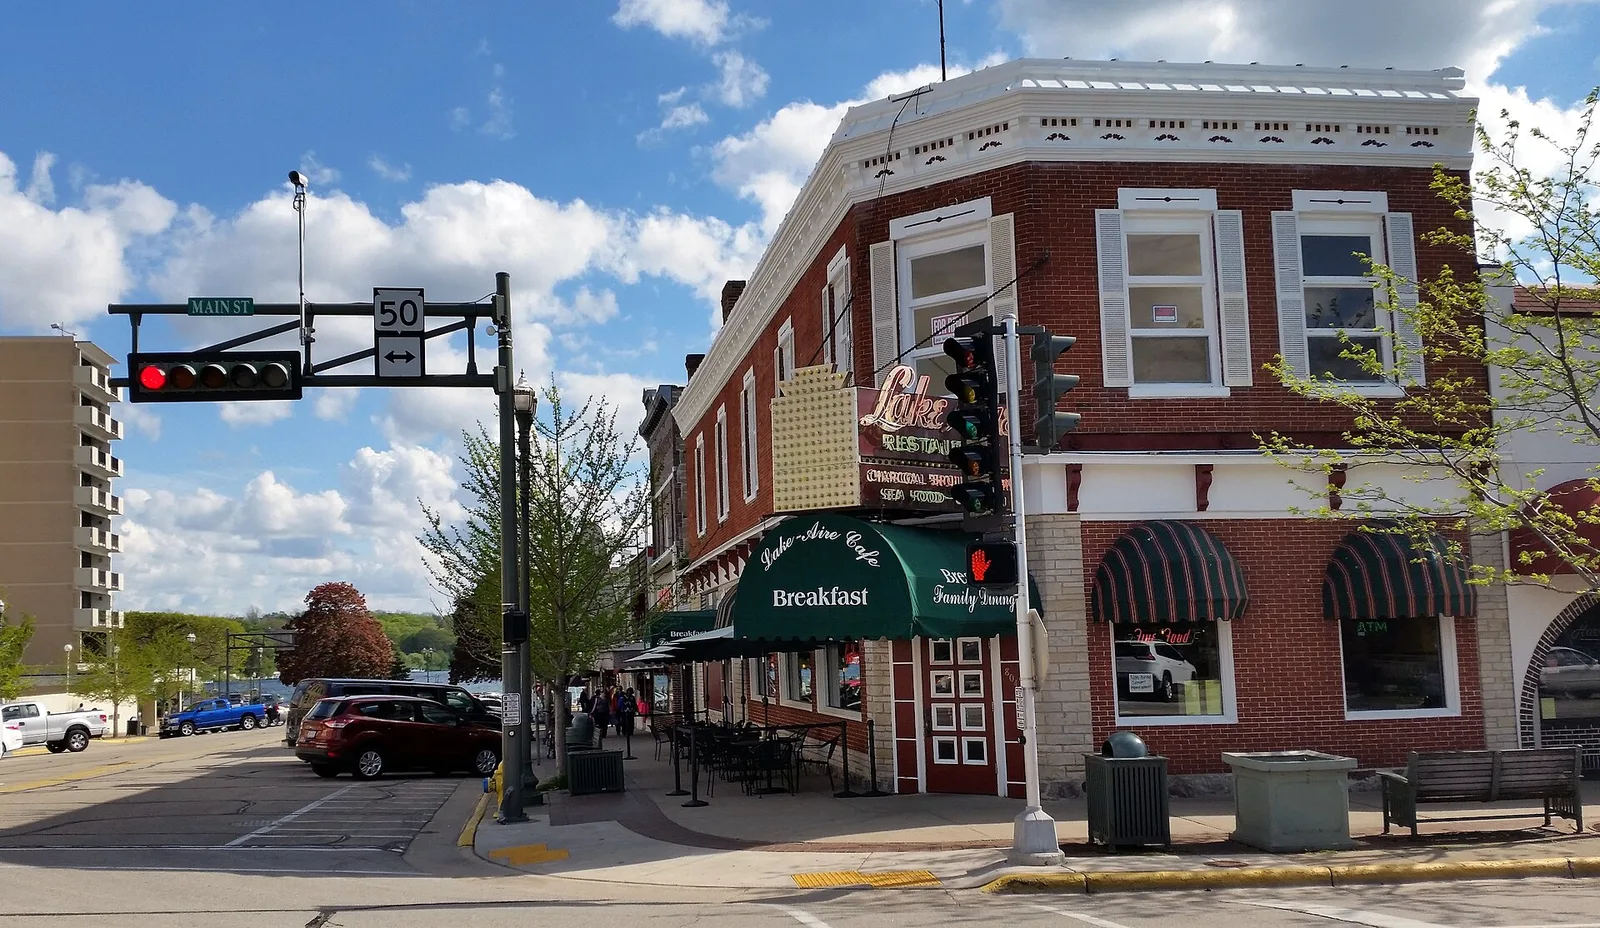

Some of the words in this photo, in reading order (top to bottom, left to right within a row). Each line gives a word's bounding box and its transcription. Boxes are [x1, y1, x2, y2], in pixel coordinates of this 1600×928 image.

[192, 300, 233, 314] MAIN
[233, 300, 250, 314] ST
[380, 299, 418, 327] 50
[860, 365, 948, 432] Lake
[866, 469, 928, 485] CHARCOAL
[880, 488, 905, 501] SEA
[846, 530, 880, 567] Cafe
[772, 586, 869, 607] Breakfast
[933, 584, 979, 613] Family
[978, 587, 1016, 613] Dining
[1357, 621, 1387, 632] ATM
